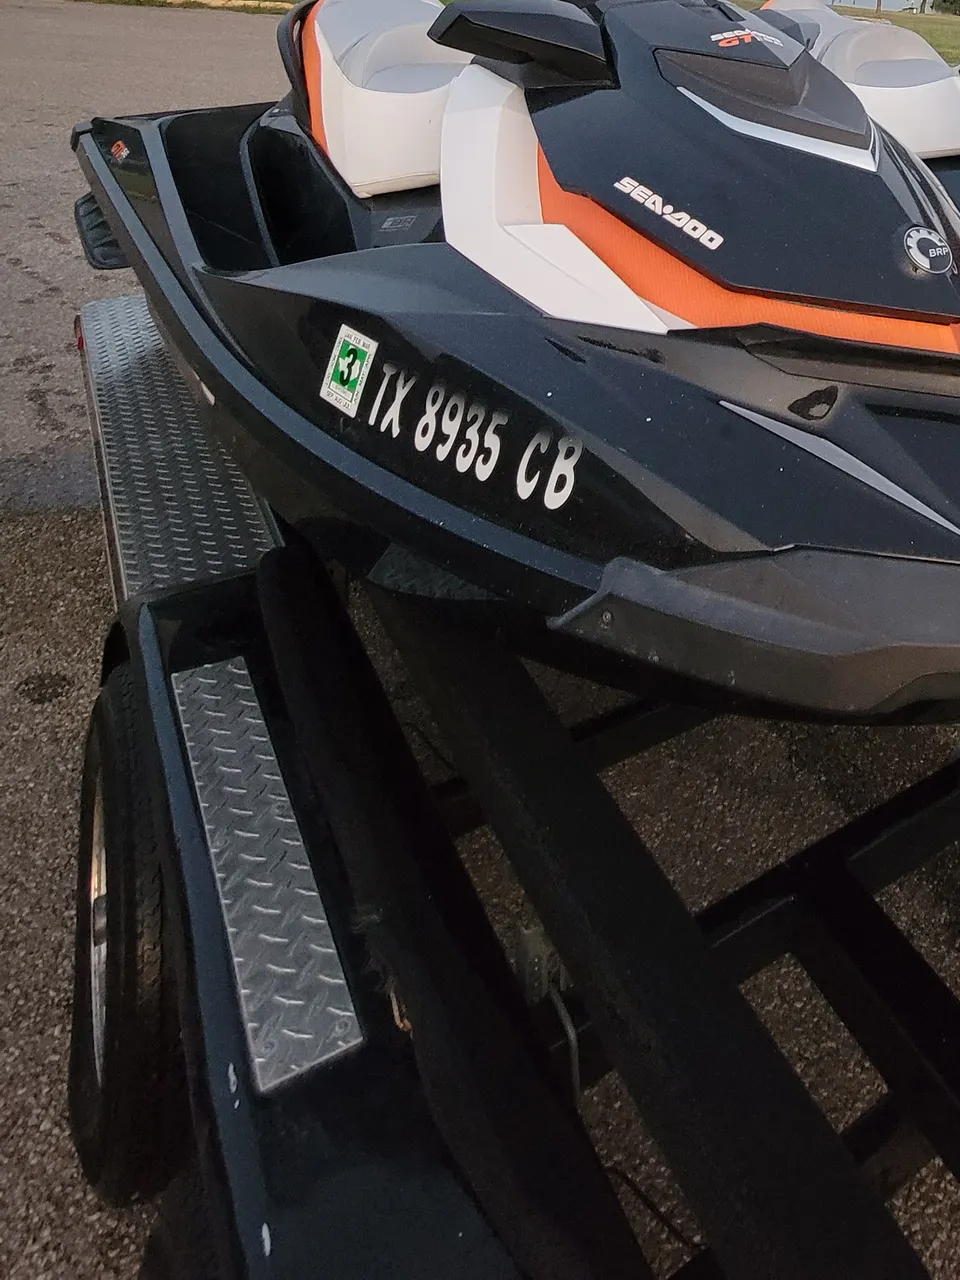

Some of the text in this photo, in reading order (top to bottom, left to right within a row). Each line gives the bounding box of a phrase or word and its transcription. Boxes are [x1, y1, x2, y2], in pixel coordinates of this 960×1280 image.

[928, 247, 949, 258] BRP
[339, 347, 358, 388] 3
[368, 362, 583, 510] TX 8935 CB
